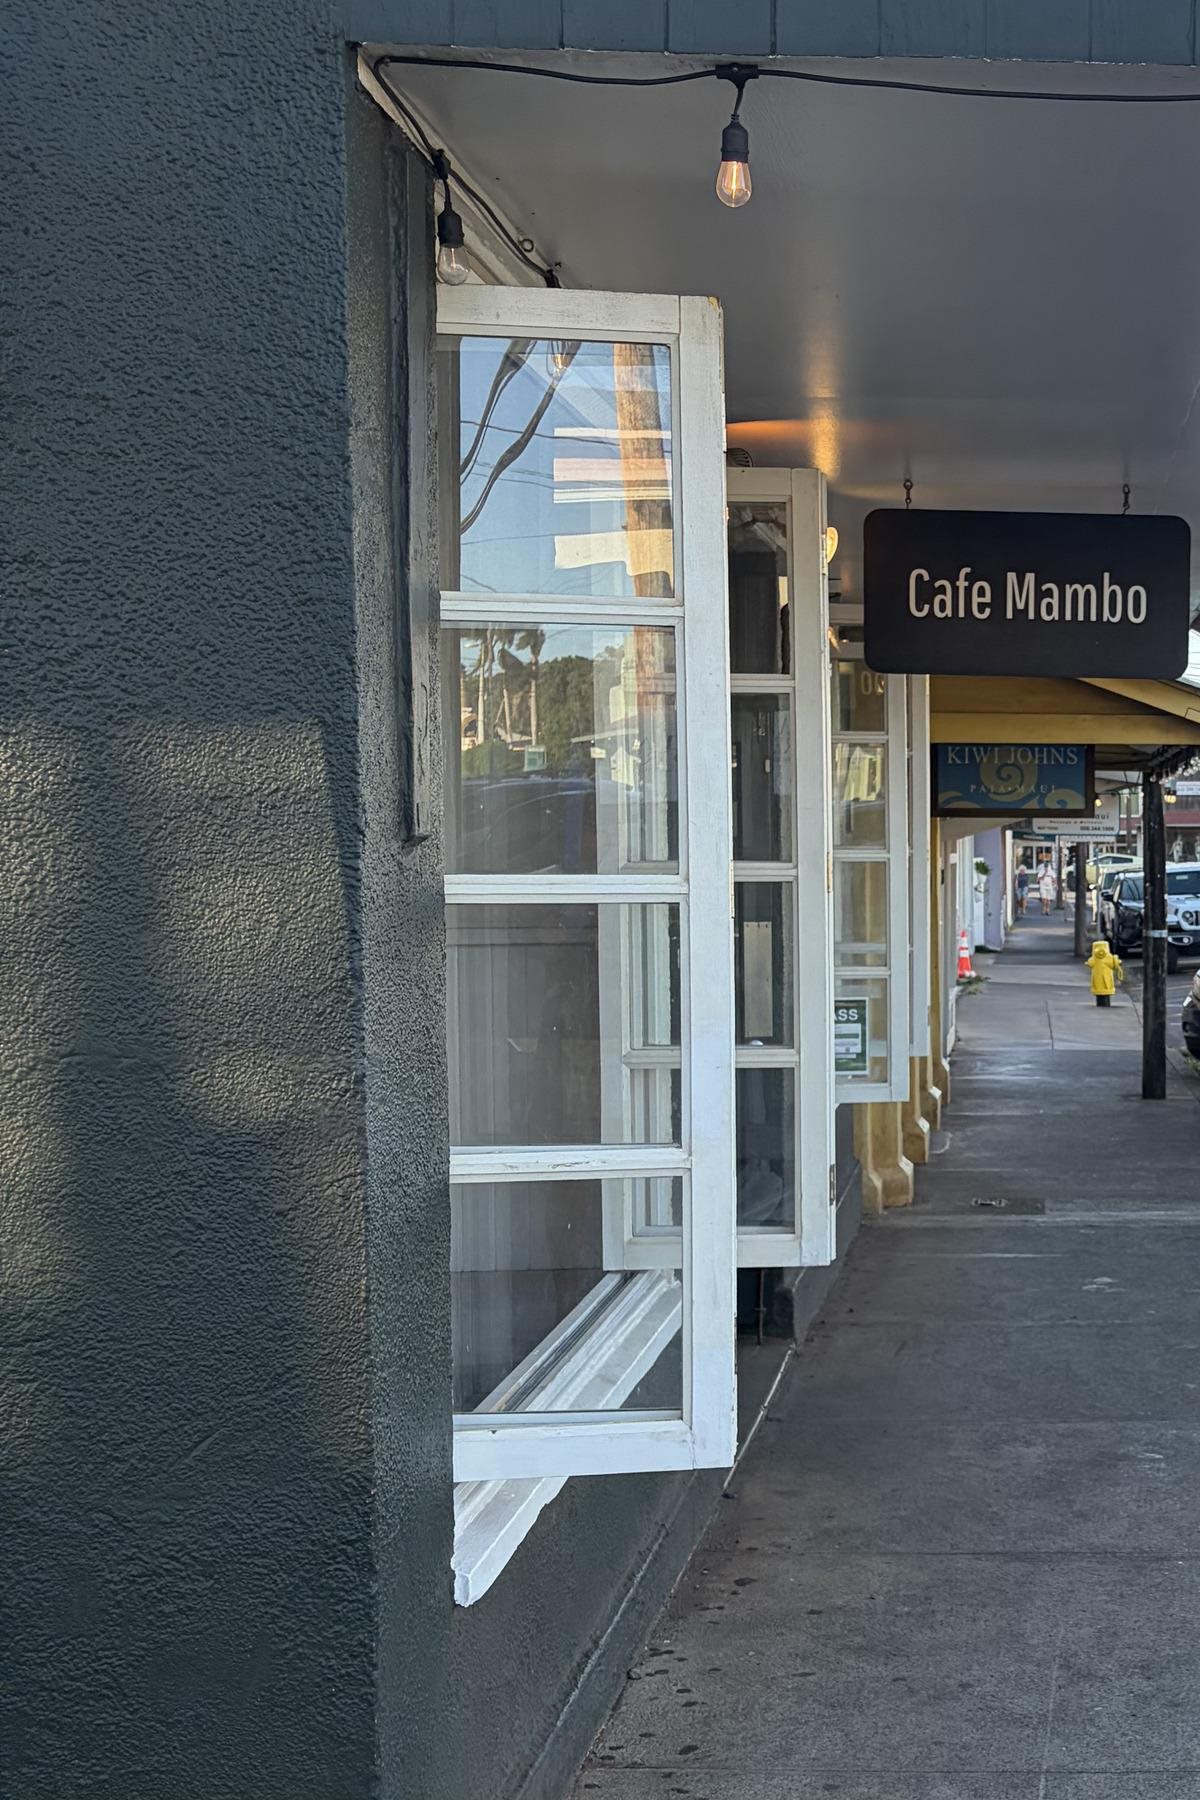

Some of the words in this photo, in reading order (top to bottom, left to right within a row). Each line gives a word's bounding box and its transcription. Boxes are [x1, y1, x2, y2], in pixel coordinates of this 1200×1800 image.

[908, 567, 992, 619] Cafe
[1005, 571, 1148, 624] Mambo
[947, 746, 999, 764] KIWI
[1007, 746, 1078, 765] JOHNS
